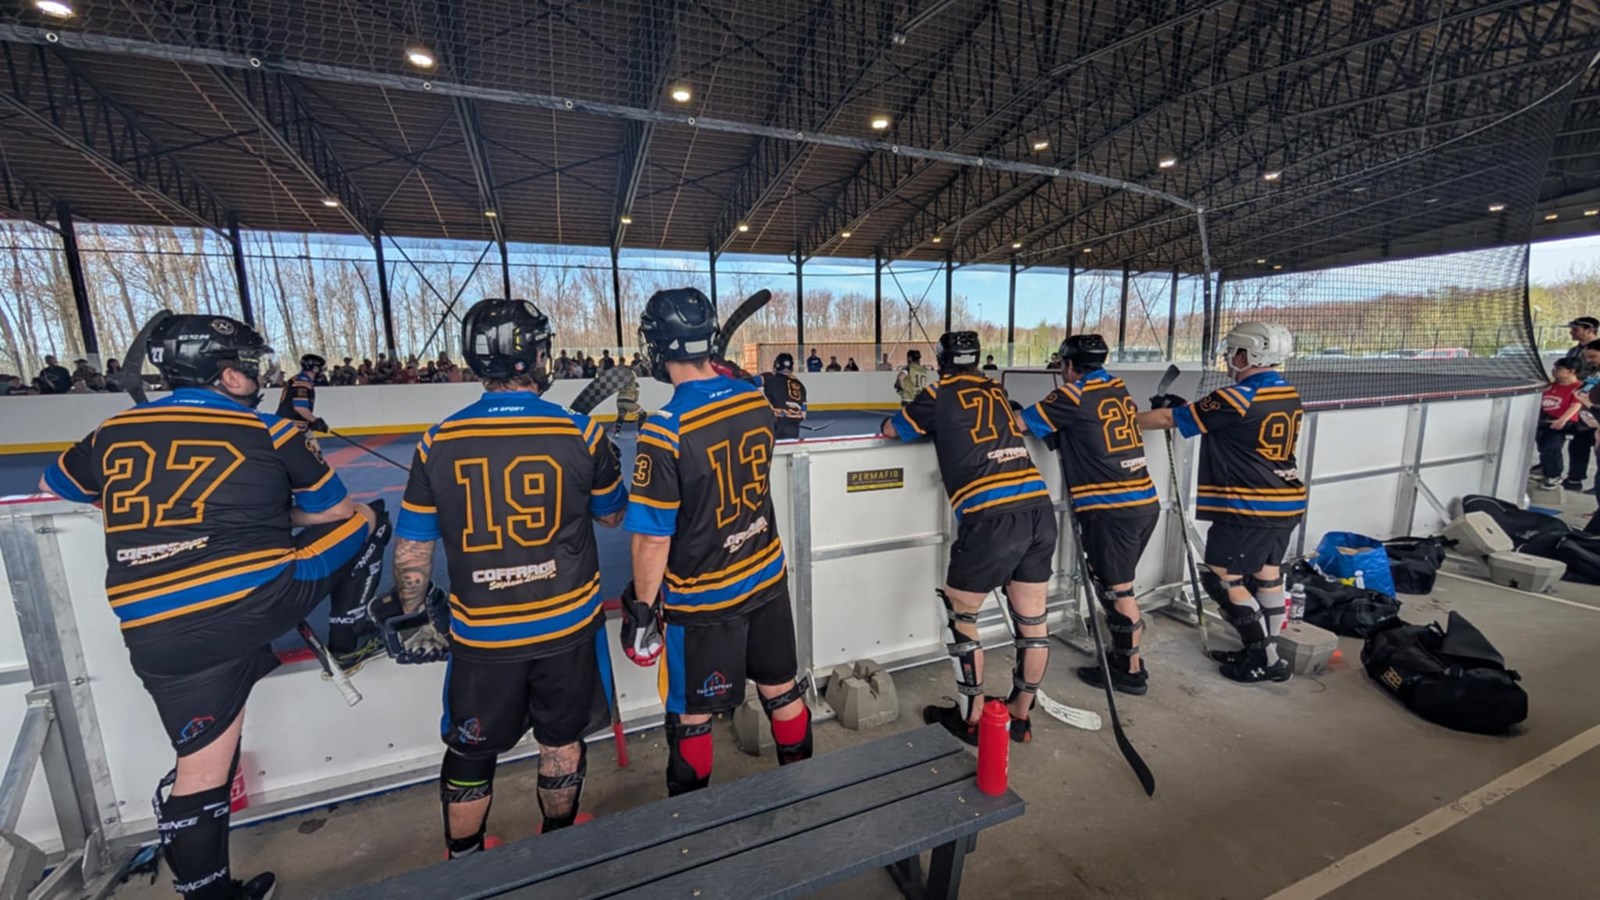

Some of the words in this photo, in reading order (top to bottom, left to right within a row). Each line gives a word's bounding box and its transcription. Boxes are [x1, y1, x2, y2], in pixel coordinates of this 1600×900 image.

[103, 439, 246, 533] 27
[454, 454, 563, 553] 19
[706, 426, 774, 529] 13
